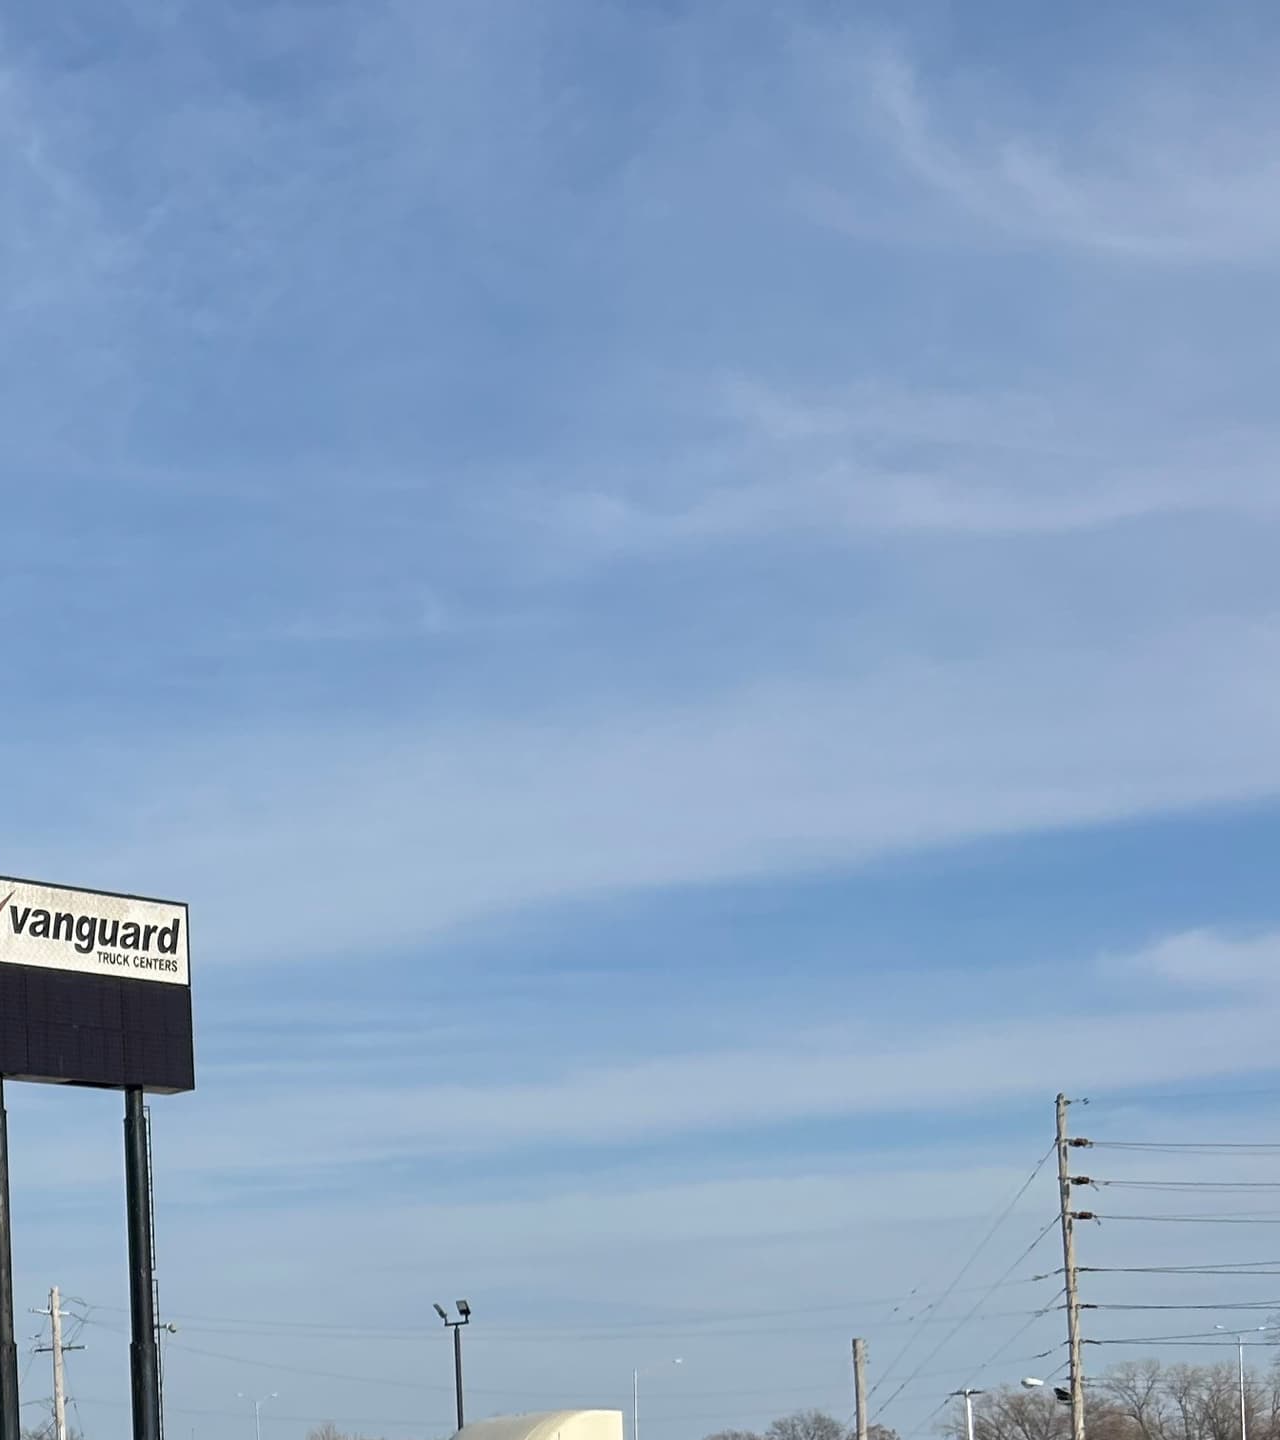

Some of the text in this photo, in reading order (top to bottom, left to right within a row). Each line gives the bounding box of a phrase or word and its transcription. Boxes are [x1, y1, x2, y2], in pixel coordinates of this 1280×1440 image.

[9, 905, 180, 955] vanguard
[97, 951, 178, 973] TRUCK CENTERS
